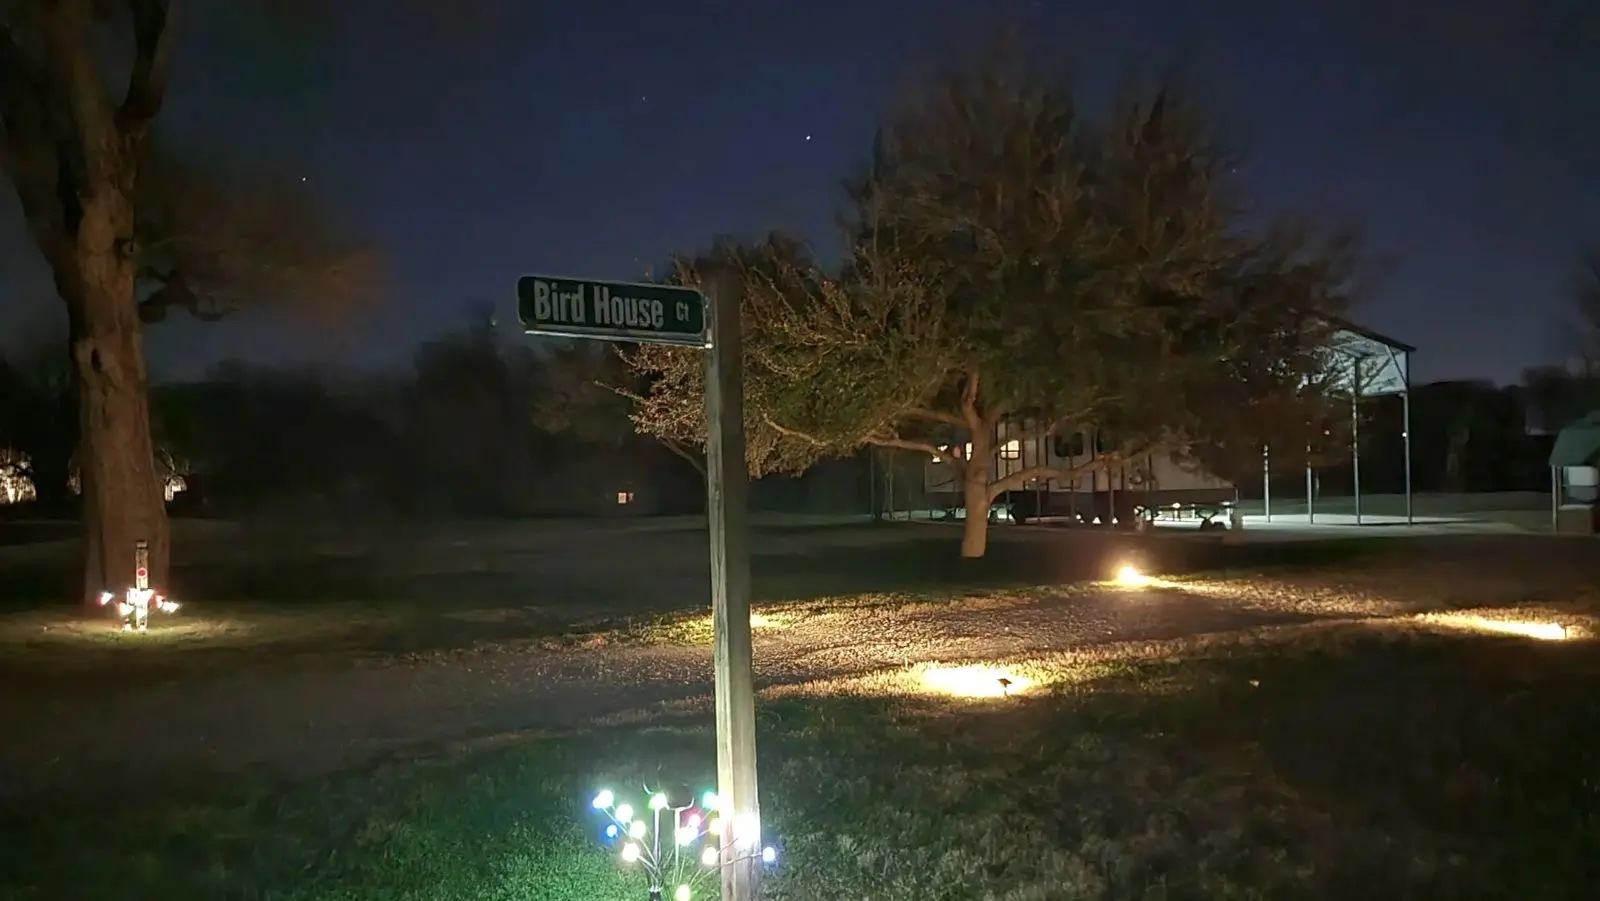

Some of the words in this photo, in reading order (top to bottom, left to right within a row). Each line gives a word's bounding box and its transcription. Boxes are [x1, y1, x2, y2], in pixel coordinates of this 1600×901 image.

[534, 280, 586, 323] Bird
[593, 286, 664, 328] House
[676, 301, 690, 321] Ct
